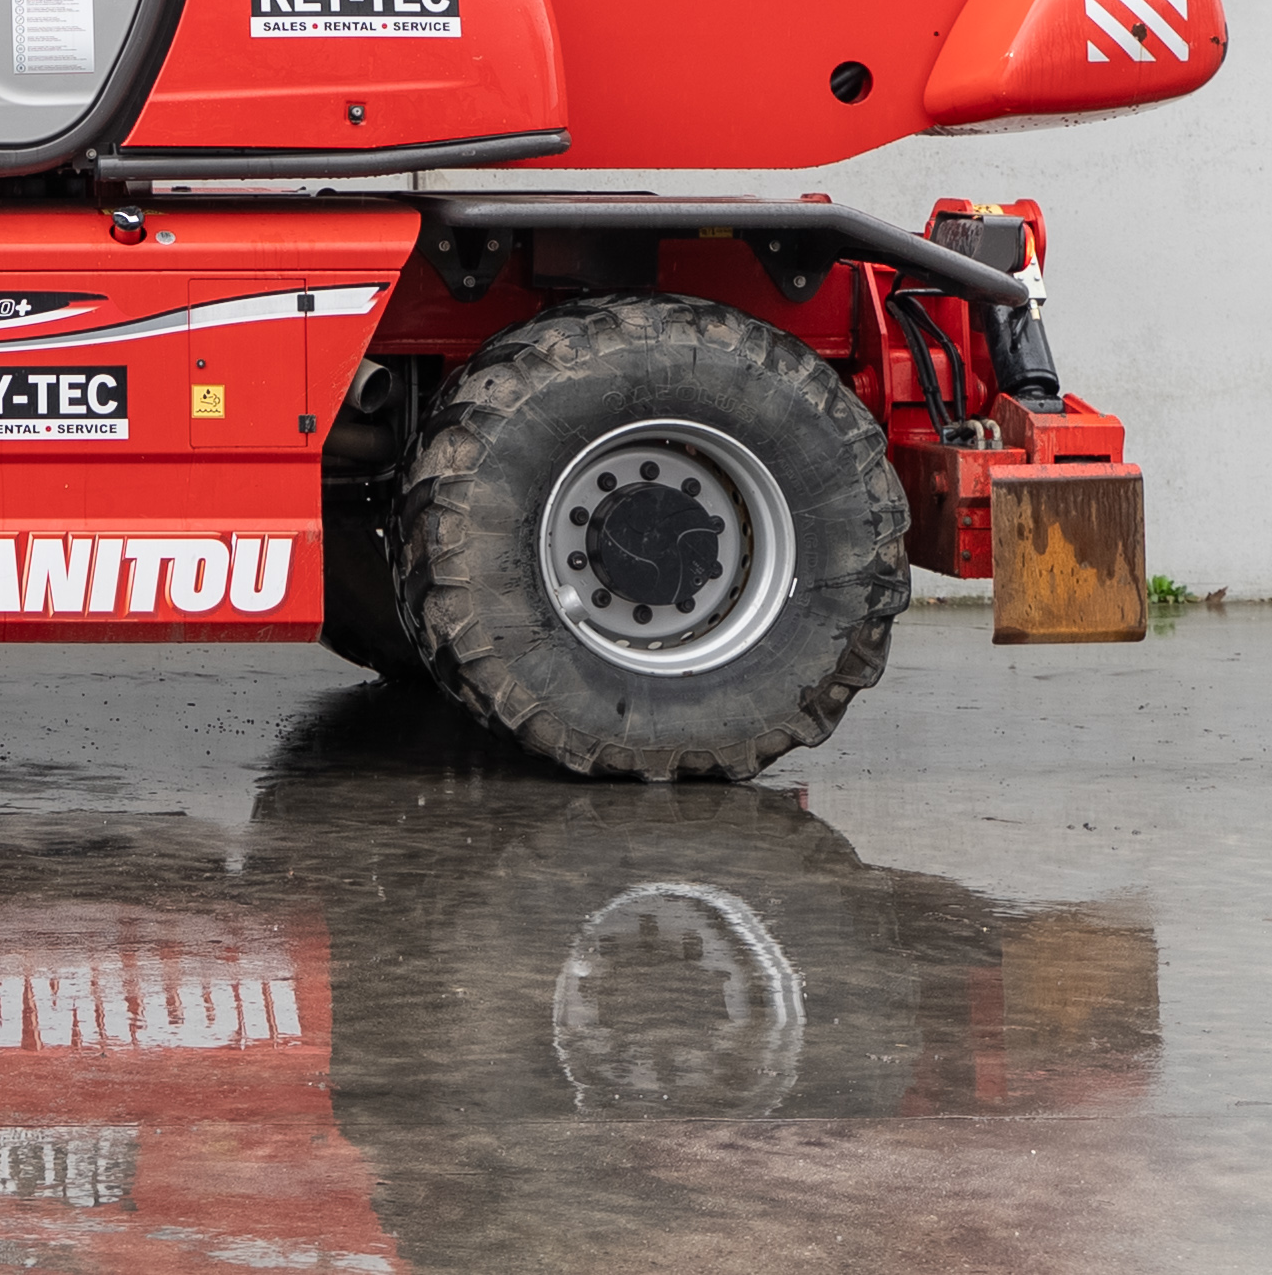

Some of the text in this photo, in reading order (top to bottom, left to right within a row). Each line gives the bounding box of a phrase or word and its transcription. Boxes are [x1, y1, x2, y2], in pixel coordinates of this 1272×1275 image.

[263, 22, 451, 32] SALES RENTAL SERVICE
[57, 423, 118, 434] SERVICE
